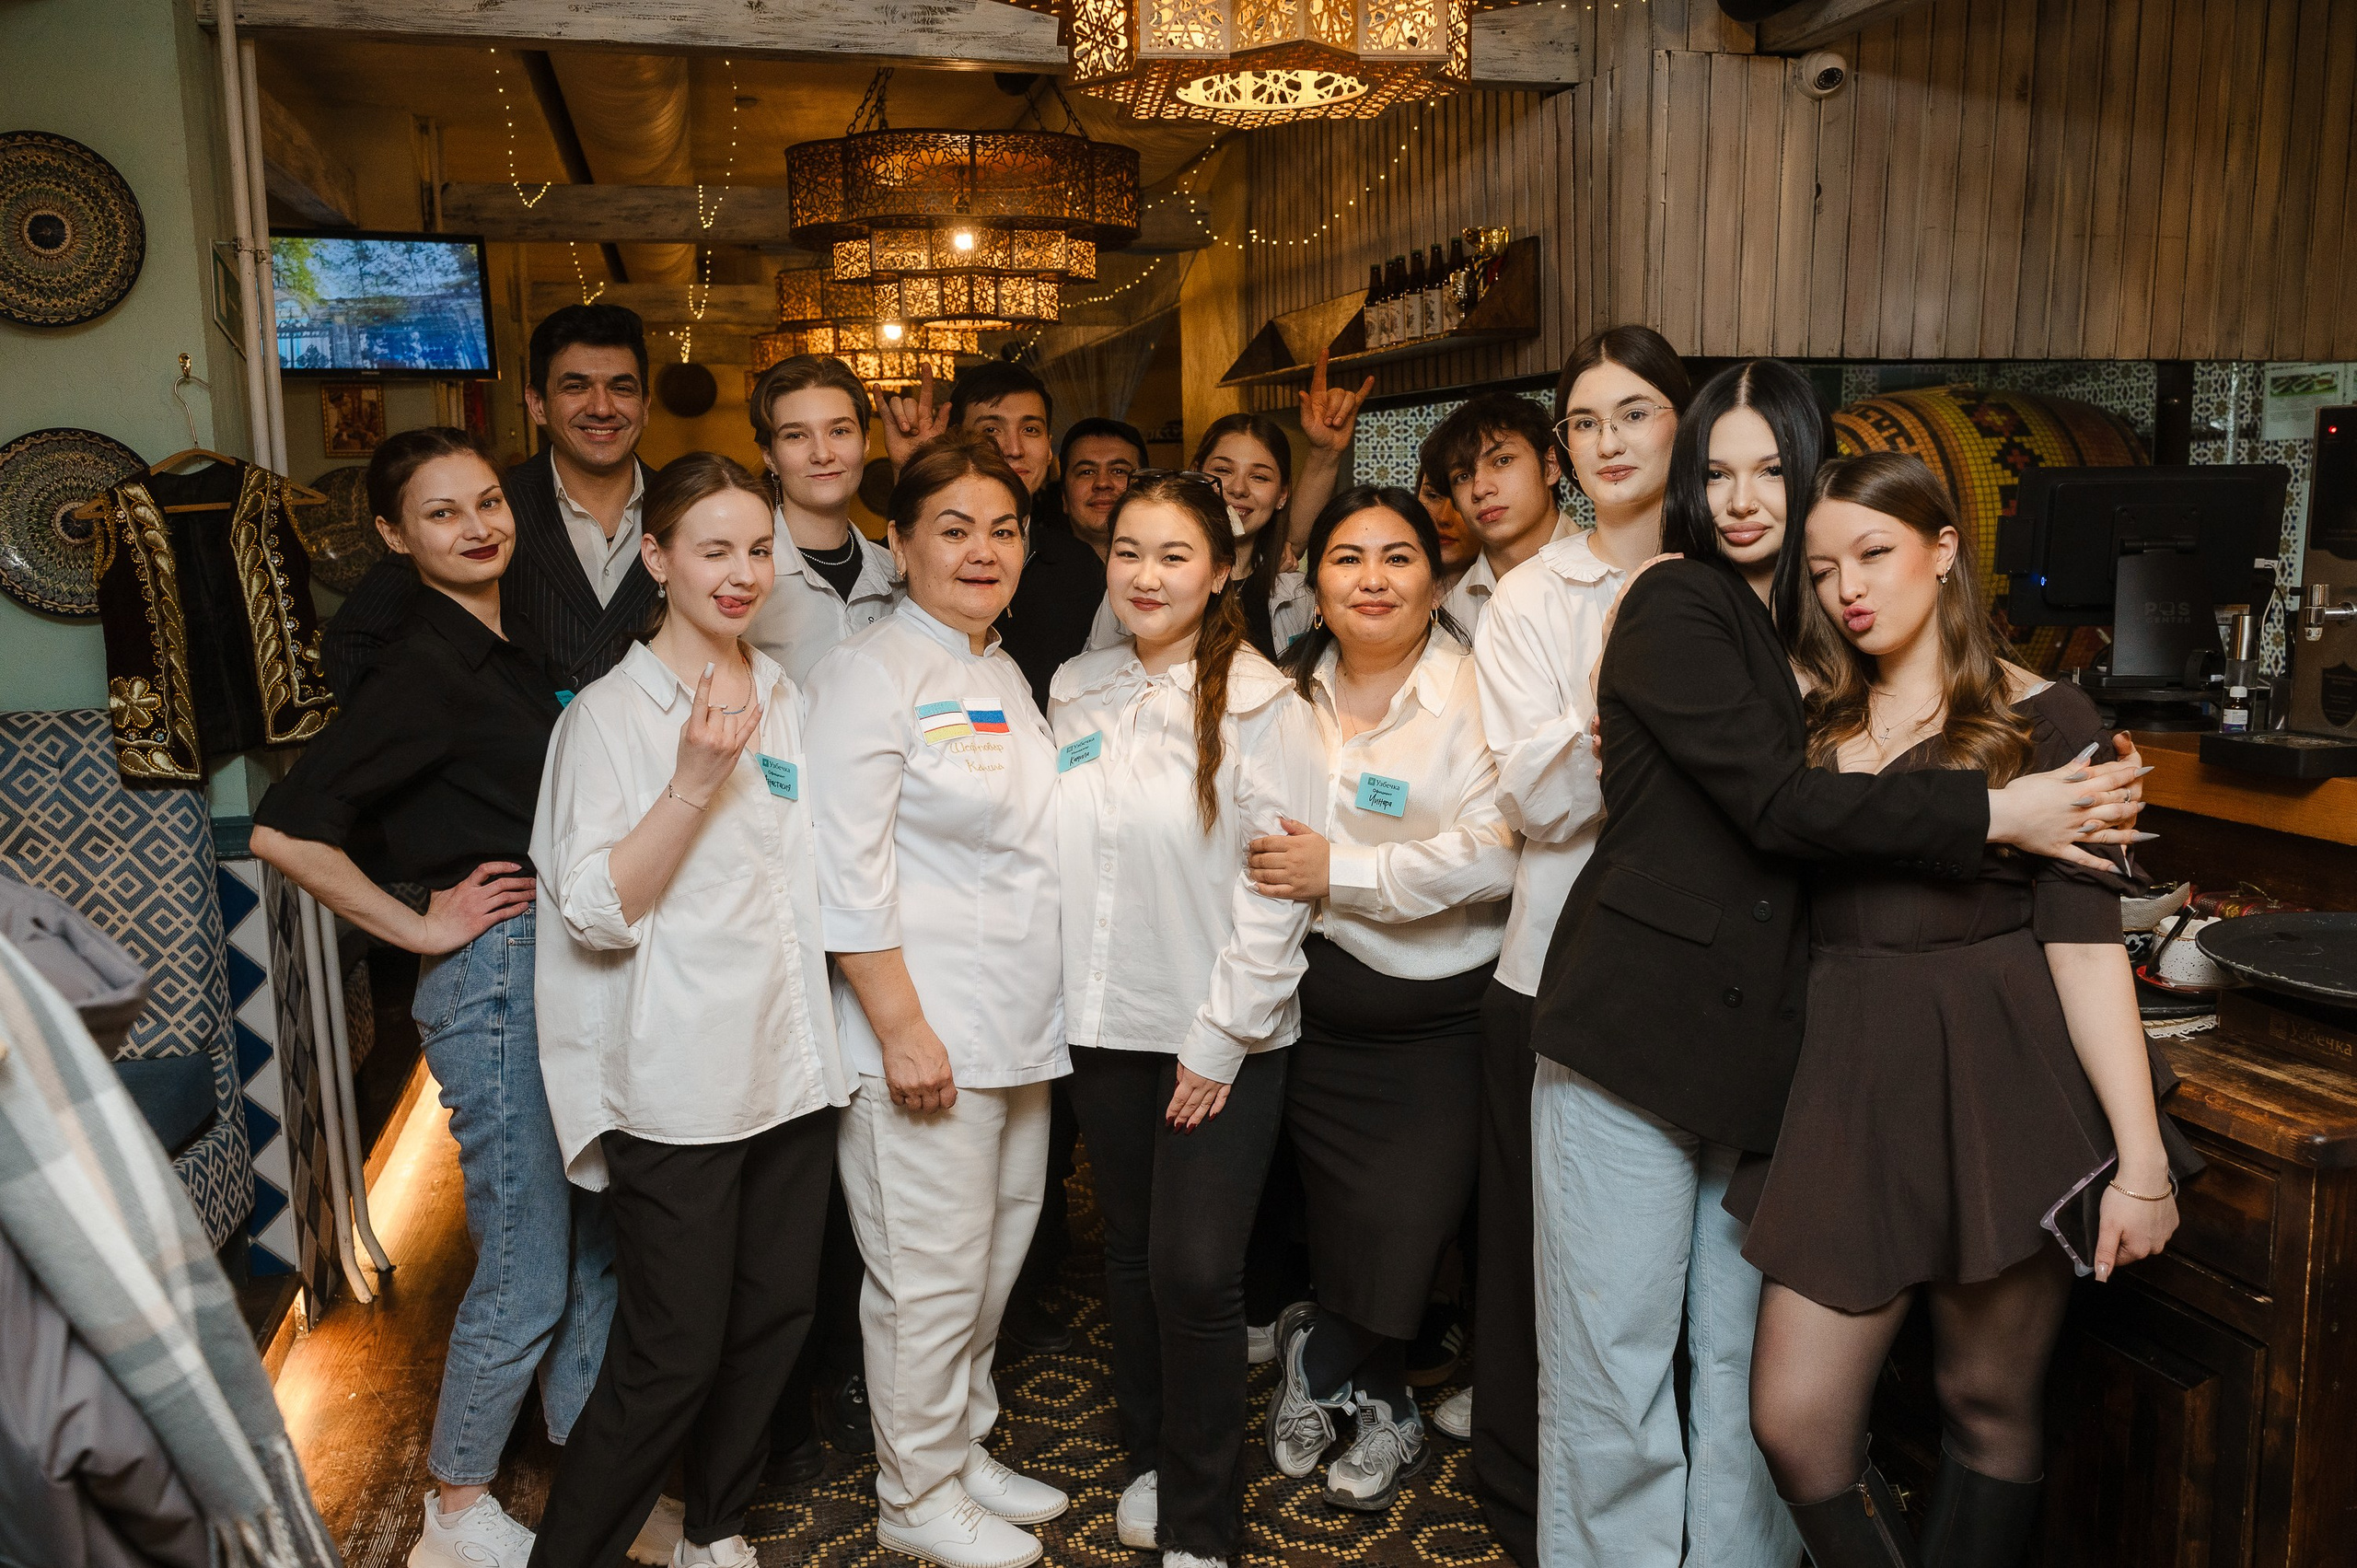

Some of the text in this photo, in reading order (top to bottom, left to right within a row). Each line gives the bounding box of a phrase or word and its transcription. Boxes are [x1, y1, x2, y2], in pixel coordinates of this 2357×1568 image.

[769, 761, 791, 772] Узбечка
[1376, 779, 1399, 791] Узбечка
[2290, 1020, 2352, 1057] Узбечка
